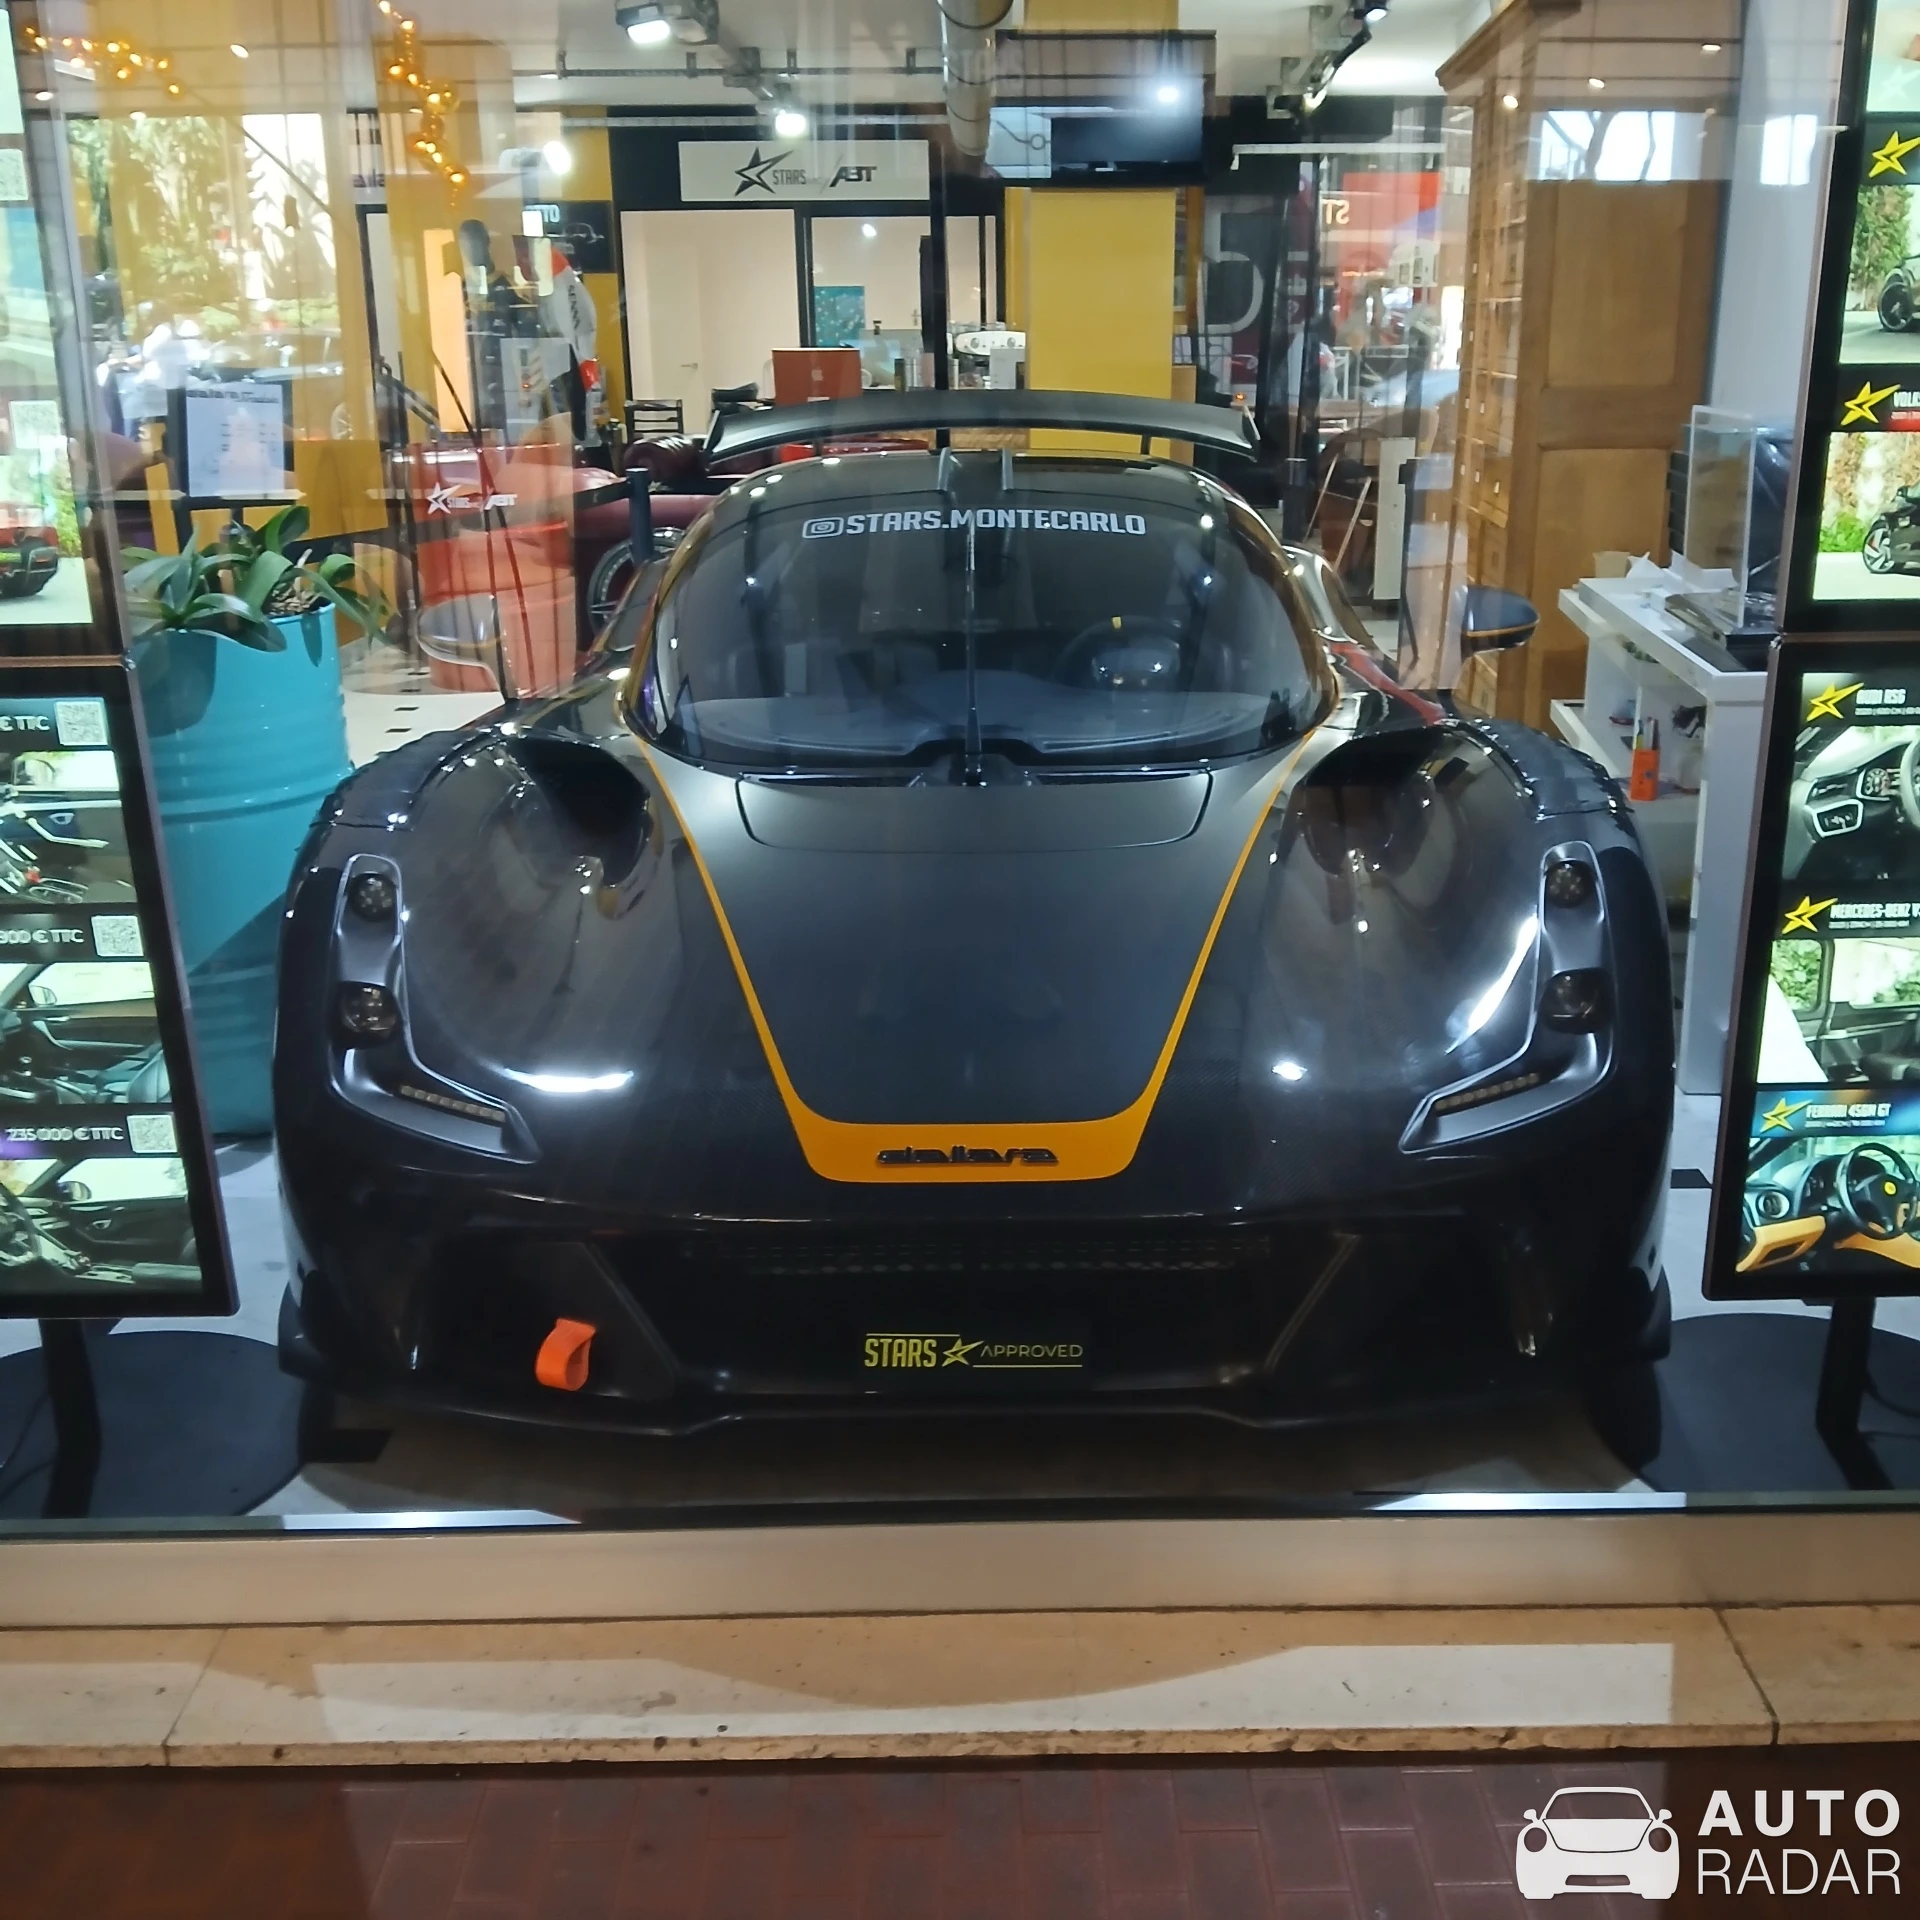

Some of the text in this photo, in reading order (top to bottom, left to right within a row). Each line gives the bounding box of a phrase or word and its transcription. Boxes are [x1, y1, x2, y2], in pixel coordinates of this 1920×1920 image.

[772, 169, 807, 186] STARS
[829, 165, 877, 188] ABT
[846, 509, 1146, 535] STARS.MONTECARLO
[14, 716, 50, 731] TTC
[32, 929, 48, 944] €
[48, 929, 84, 943] TTC
[73, 1127, 90, 1141] €
[90, 1127, 124, 1140] TTC
[877, 1145, 1059, 1165] dallara
[864, 1338, 1083, 1367] STARS APPROVED
